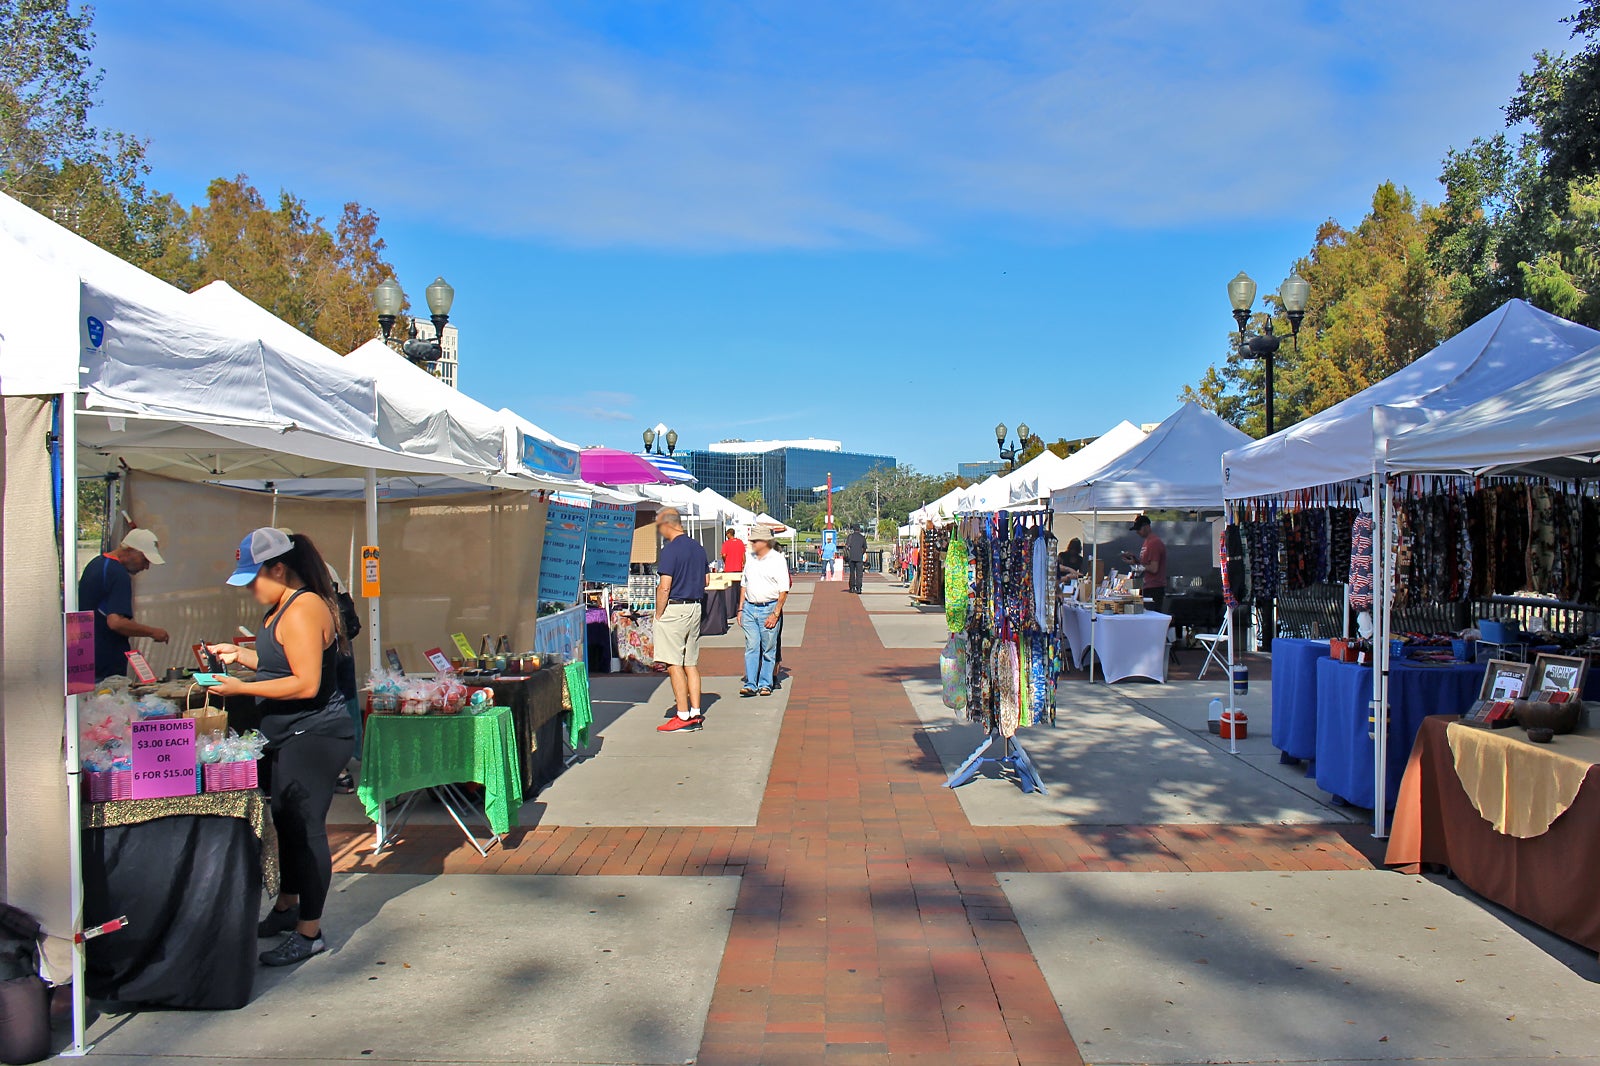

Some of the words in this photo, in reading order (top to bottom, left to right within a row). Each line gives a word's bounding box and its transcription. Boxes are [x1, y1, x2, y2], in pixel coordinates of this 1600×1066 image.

[560, 513, 585, 522] DIPS
[1550, 666, 1572, 679] SICILY
[132, 722, 158, 734] BATH
[160, 722, 194, 732] BOMBS
[137, 739, 163, 750] $3.00
[165, 738, 189, 747] EACH
[157, 754, 171, 763] OR
[134, 772, 140, 781] 6
[142, 771, 161, 780] FOR
[163, 768, 194, 779] $15.00
